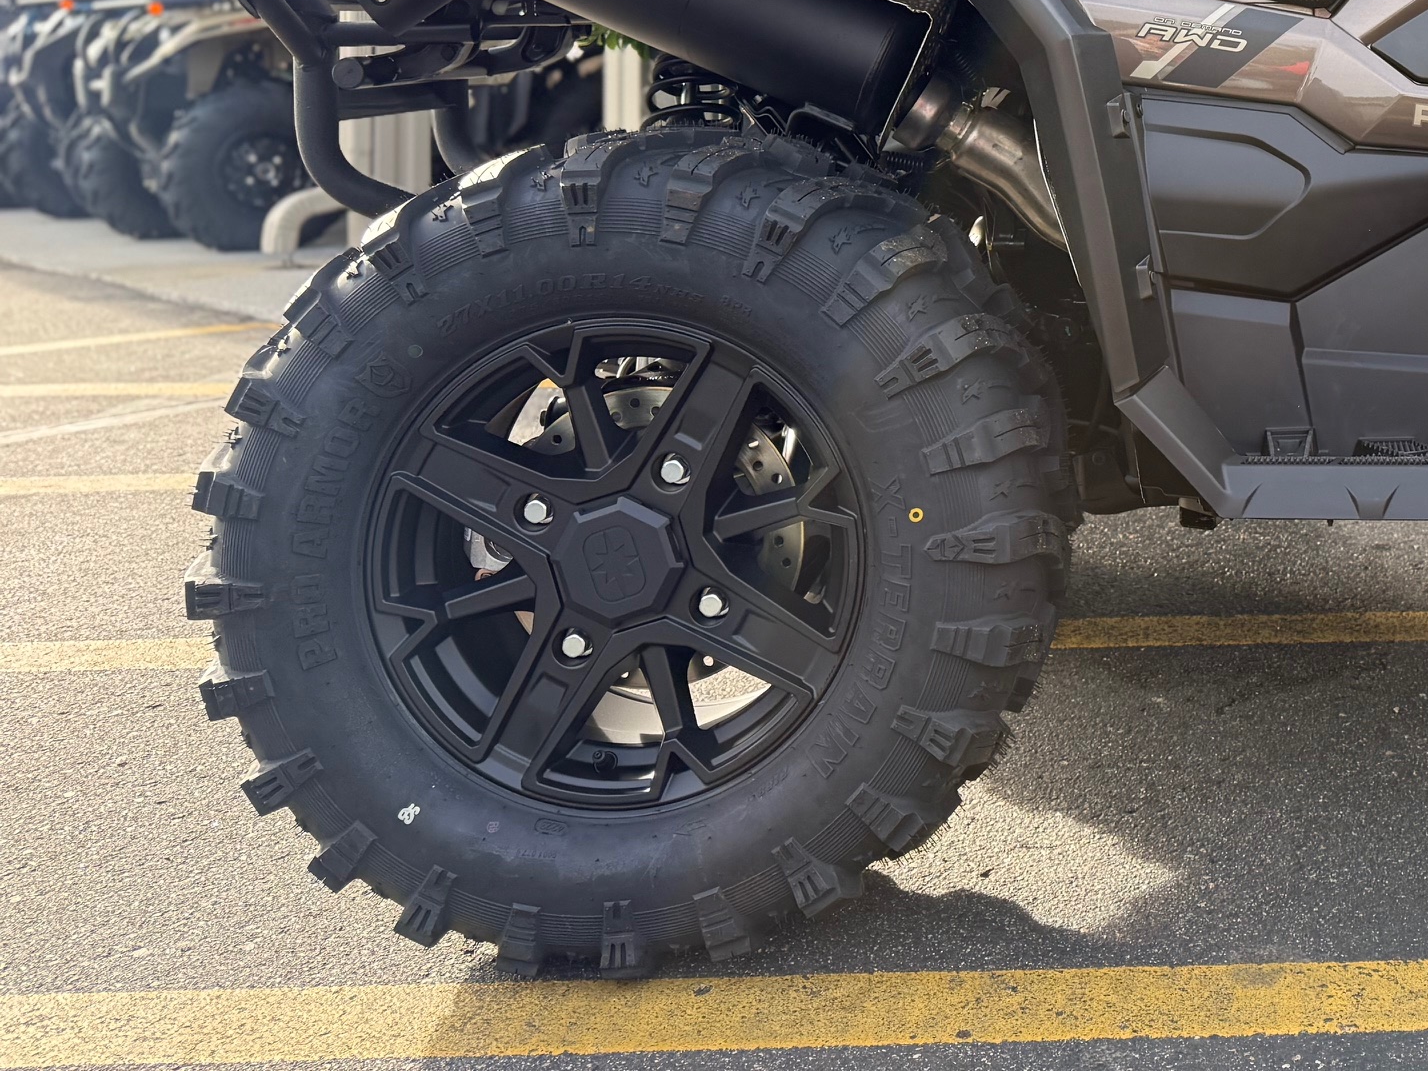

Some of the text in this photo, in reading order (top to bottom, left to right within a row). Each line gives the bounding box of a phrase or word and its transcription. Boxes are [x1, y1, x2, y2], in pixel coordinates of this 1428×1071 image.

[1136, 22, 1248, 53] AWD
[290, 398, 380, 671] PRO ARMOR
[806, 476, 912, 779] X-TERRAIN
